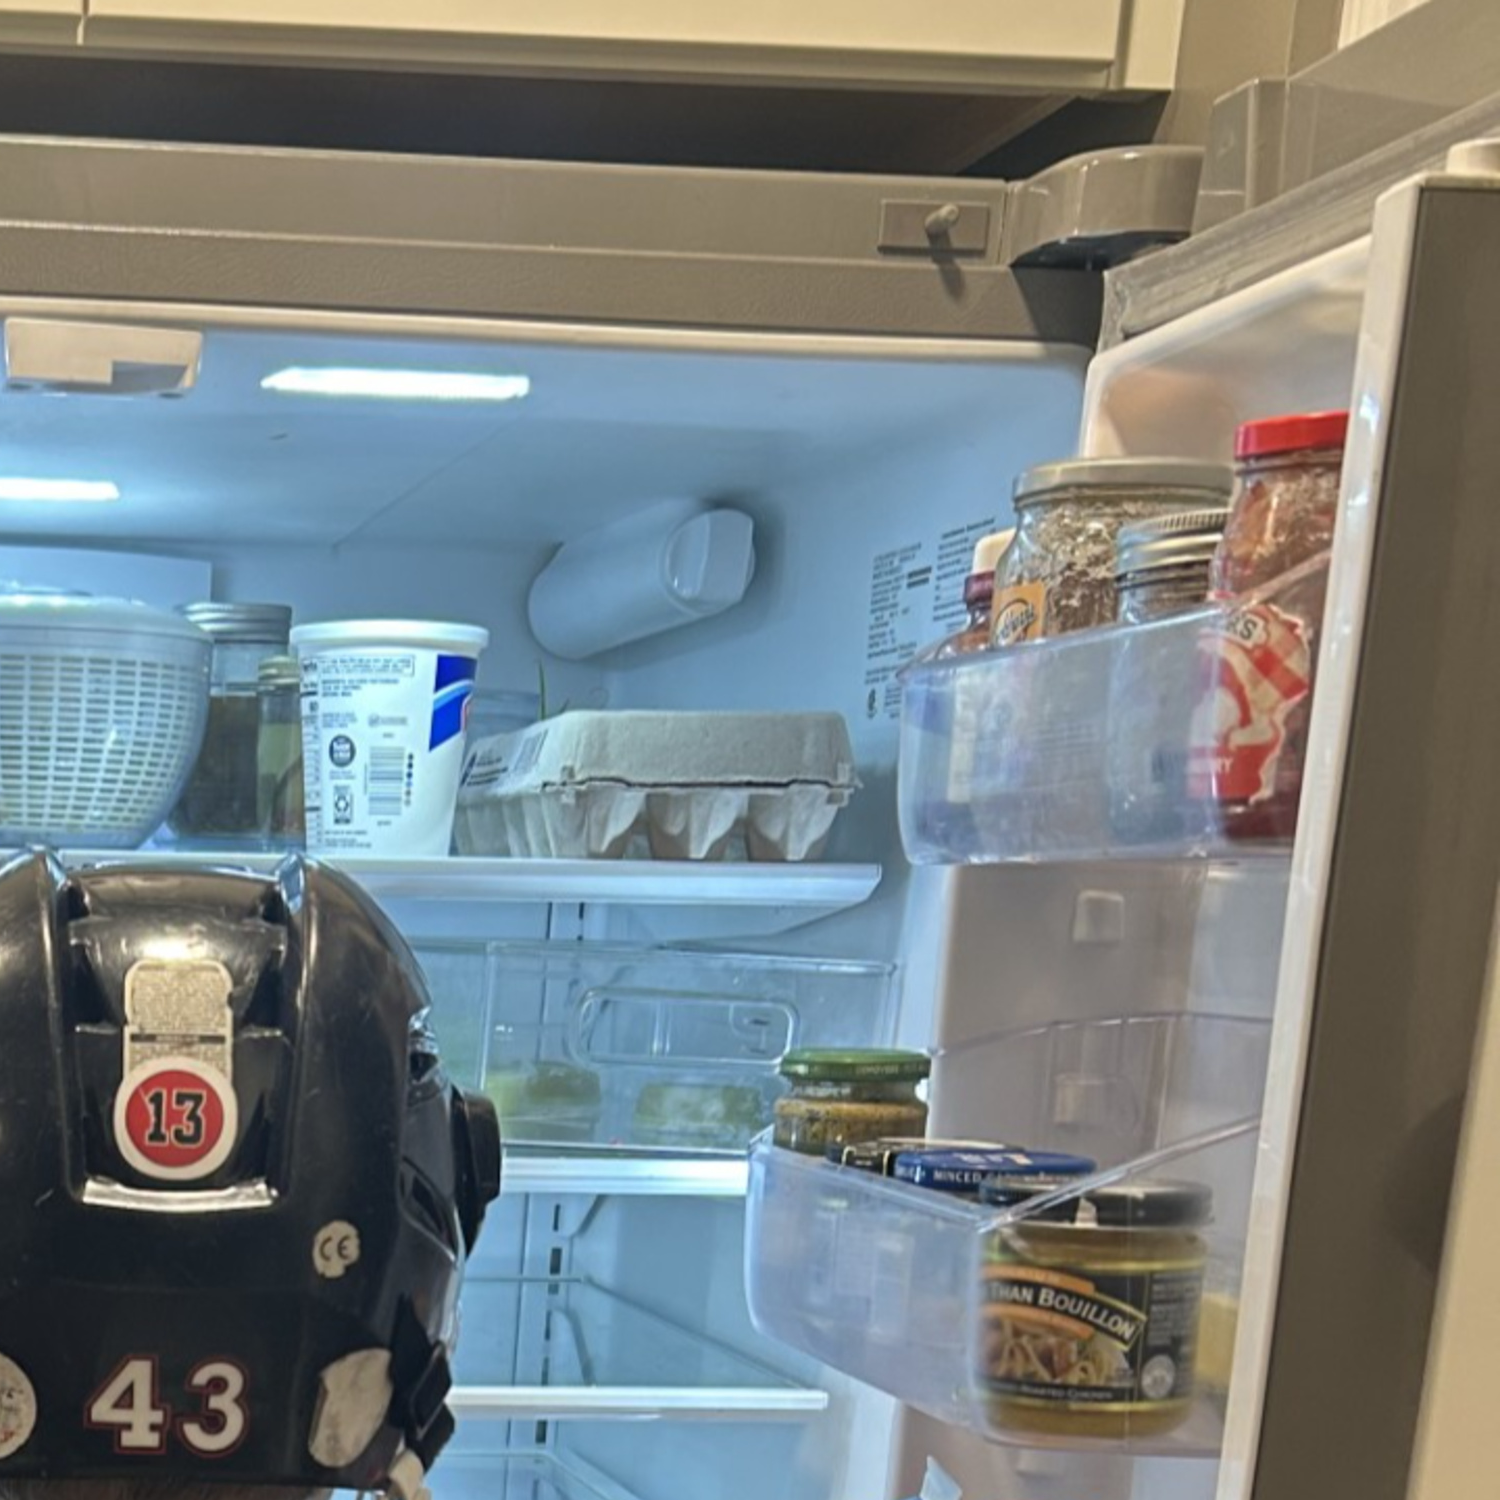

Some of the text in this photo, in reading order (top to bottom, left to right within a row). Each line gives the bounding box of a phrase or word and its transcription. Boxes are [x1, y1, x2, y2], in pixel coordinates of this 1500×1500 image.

[145, 1088, 207, 1147] 13
[933, 1168, 983, 1185] MINCED
[318, 1236, 352, 1262] CE
[1038, 1287, 1136, 1341] BOUILLON
[83, 1353, 252, 1458] 43
